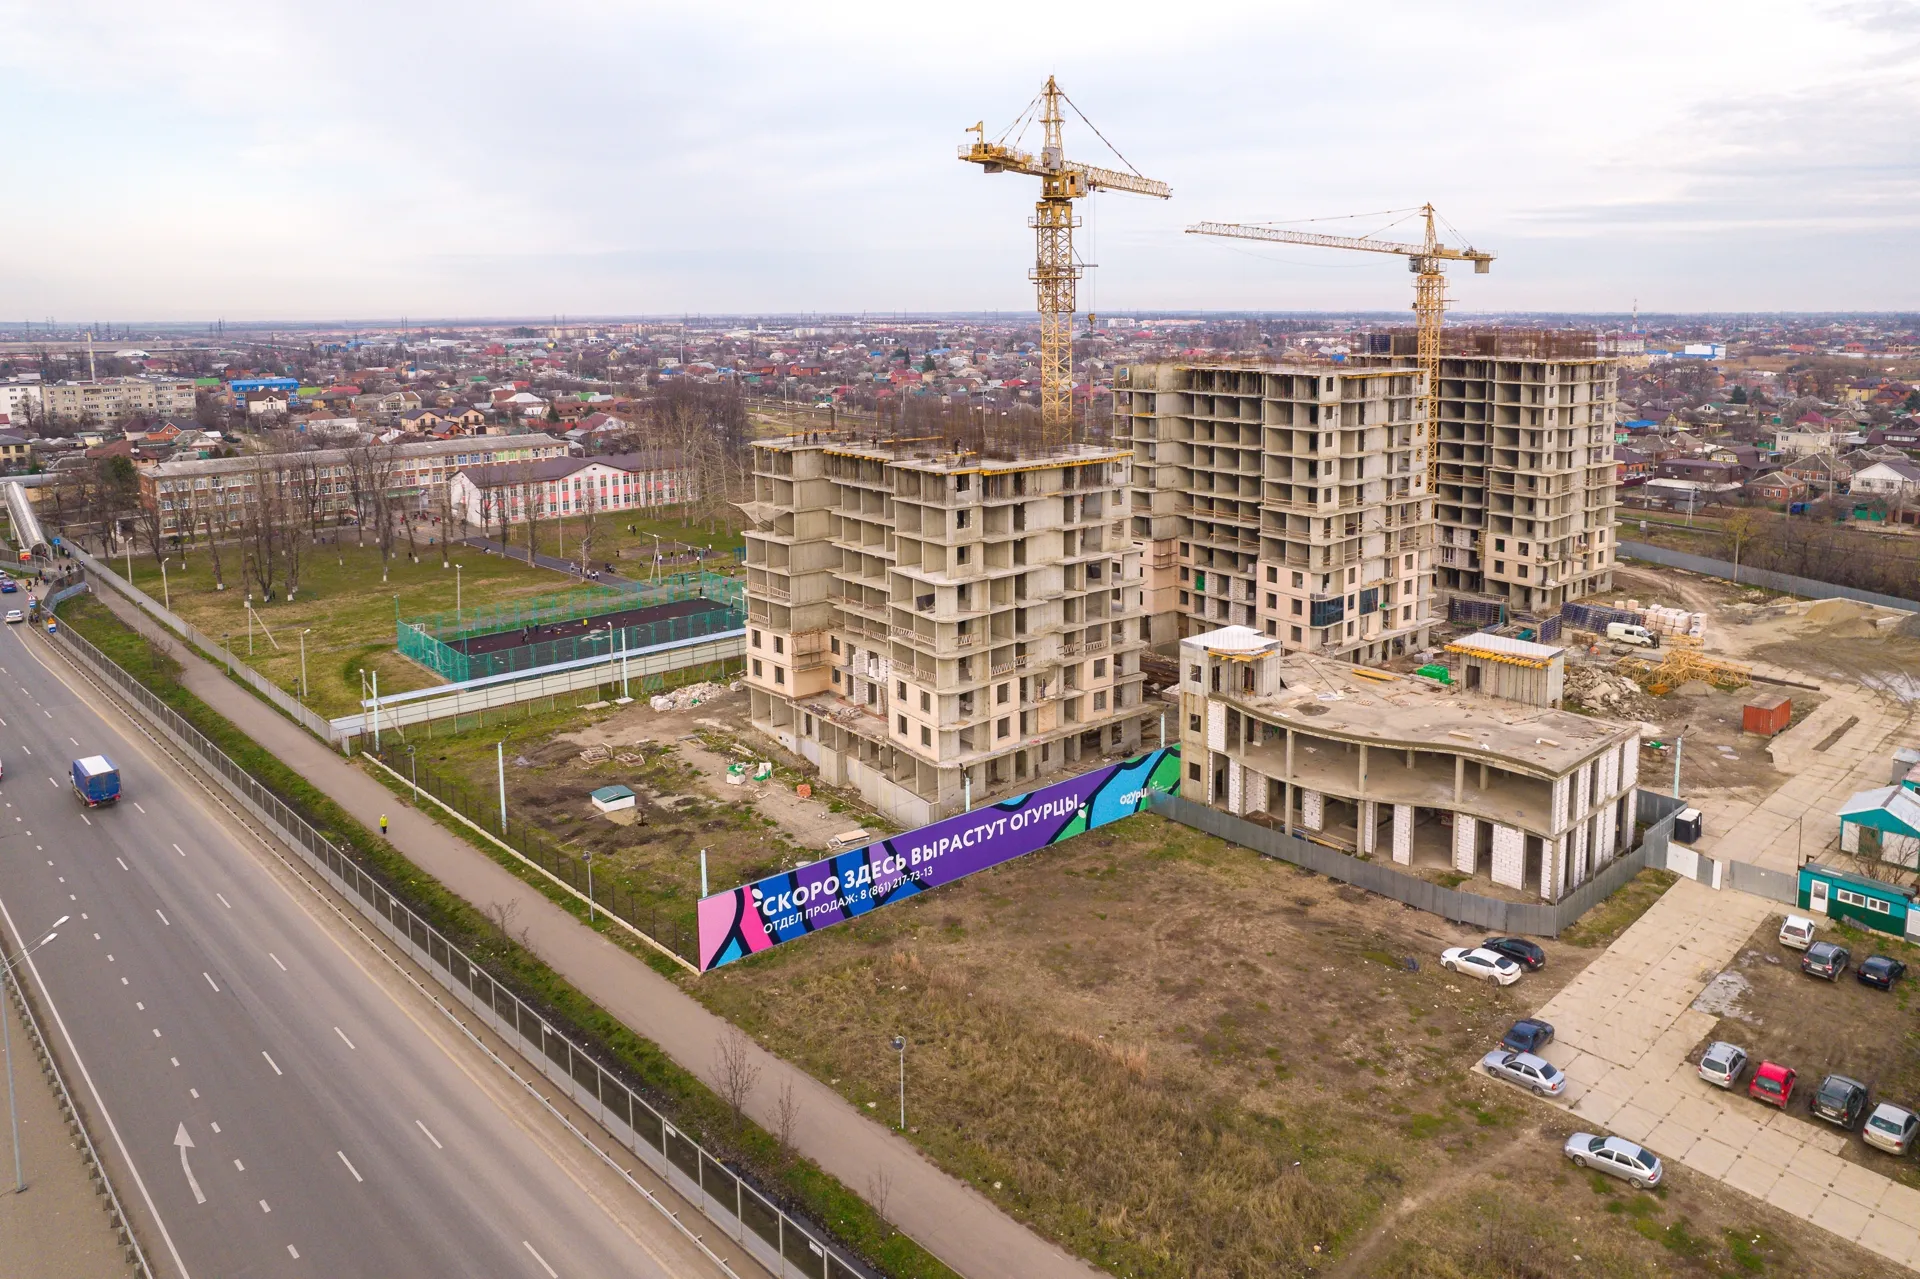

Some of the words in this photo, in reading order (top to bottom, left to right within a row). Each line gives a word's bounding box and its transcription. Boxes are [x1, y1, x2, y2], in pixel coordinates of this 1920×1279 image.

[762, 875, 840, 917] СКОРО
[844, 853, 907, 889] ЗДЕСЬ
[911, 818, 1007, 866] ВЫРАСТУТ
[1010, 794, 1079, 831] ОГУРЦЫ
[763, 912, 803, 934] ОТДЕЛ
[805, 892, 859, 920] ПРОДАЖ:
[860, 889, 867, 900] 8
[868, 881, 892, 899] (861)
[892, 866, 933, 889] 217-73-13
